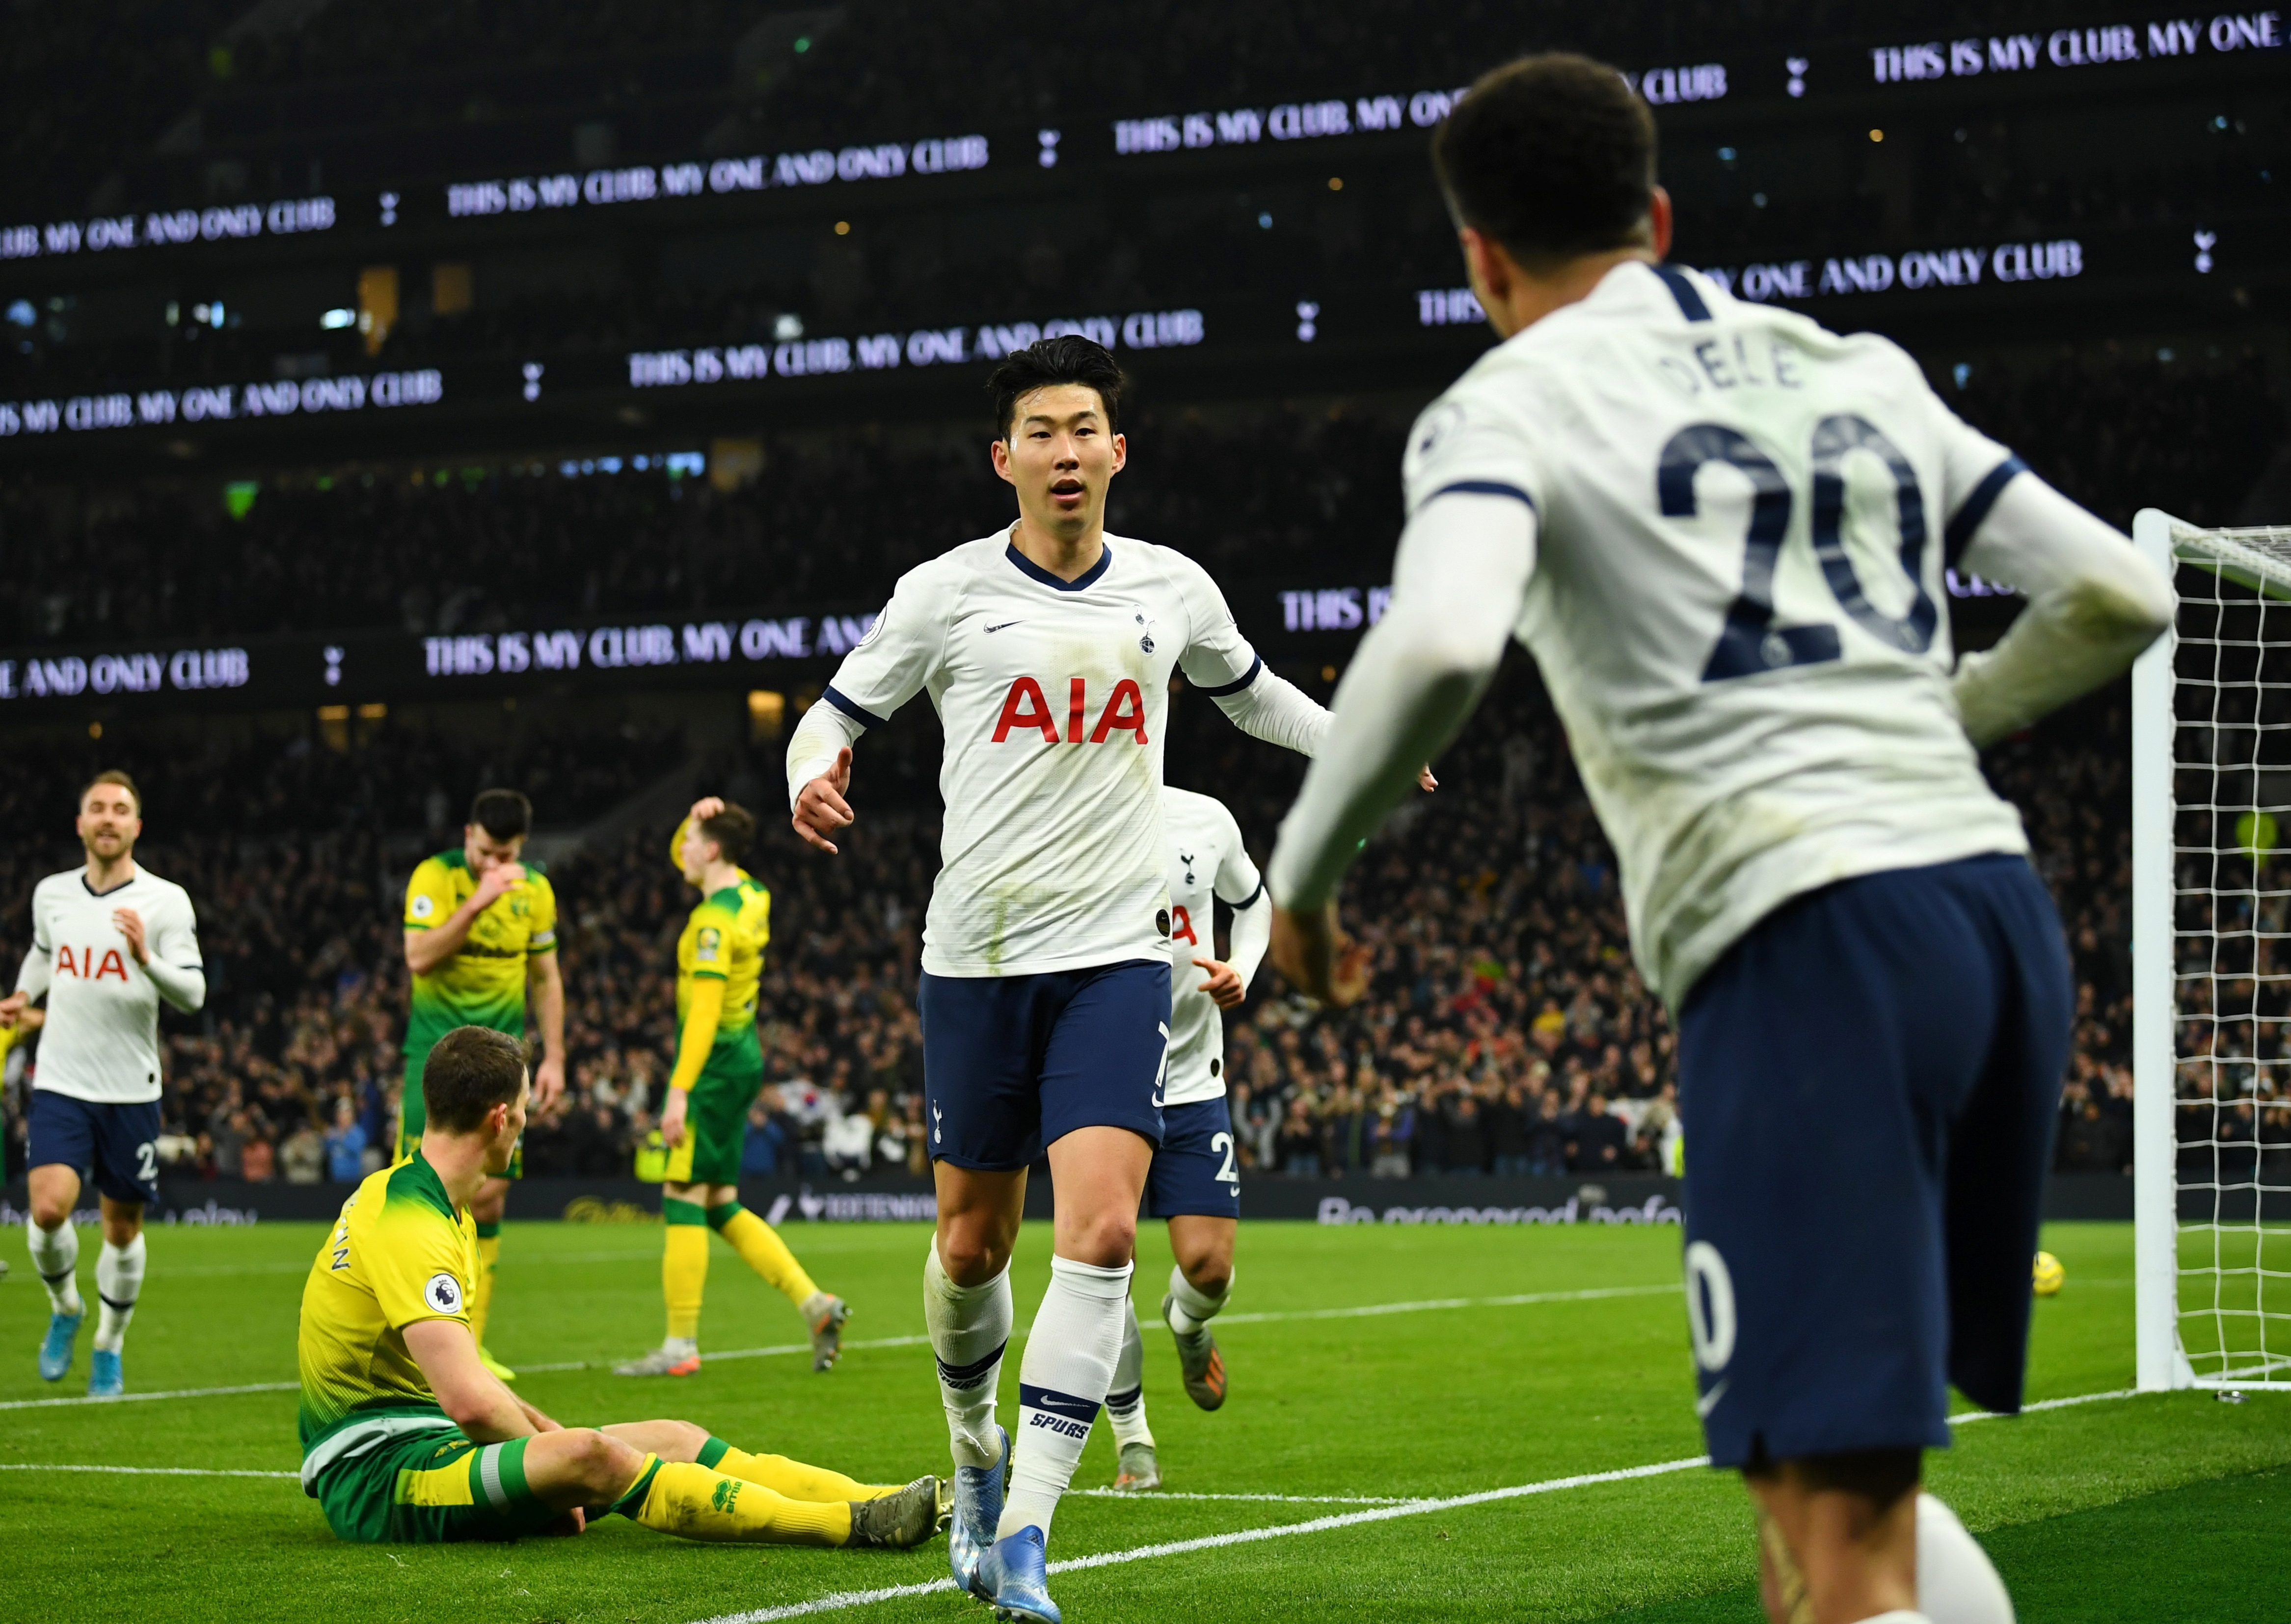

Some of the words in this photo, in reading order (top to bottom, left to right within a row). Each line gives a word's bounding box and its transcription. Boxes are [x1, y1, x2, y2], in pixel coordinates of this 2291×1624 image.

[1989, 35, 2042, 71] MY
[2148, 20, 2201, 56] MY
[1216, 109, 1266, 143] MY
[1356, 95, 1407, 130] MY
[1642, 64, 1727, 104] CLUB
[537, 174, 583, 207] MY
[661, 162, 708, 196] MY
[911, 134, 989, 174] CLUB
[44, 222, 84, 253] MY
[267, 197, 336, 234] CLUB
[1993, 240, 2083, 281] CLUB
[724, 345, 772, 379] MY
[856, 334, 904, 369] MY
[1122, 309, 1204, 348] CLUB
[22, 400, 63, 432] MY
[137, 391, 180, 424] MY
[371, 369, 443, 406] CLUB
[1657, 413, 1938, 682] 20
[169, 648, 249, 690] CLUB
[533, 630, 586, 669] MY
[682, 622, 737, 662] MY
[991, 676, 1148, 745] AIA
[56, 945, 129, 982] AIA
[1029, 1412, 1089, 1439] SPURS
